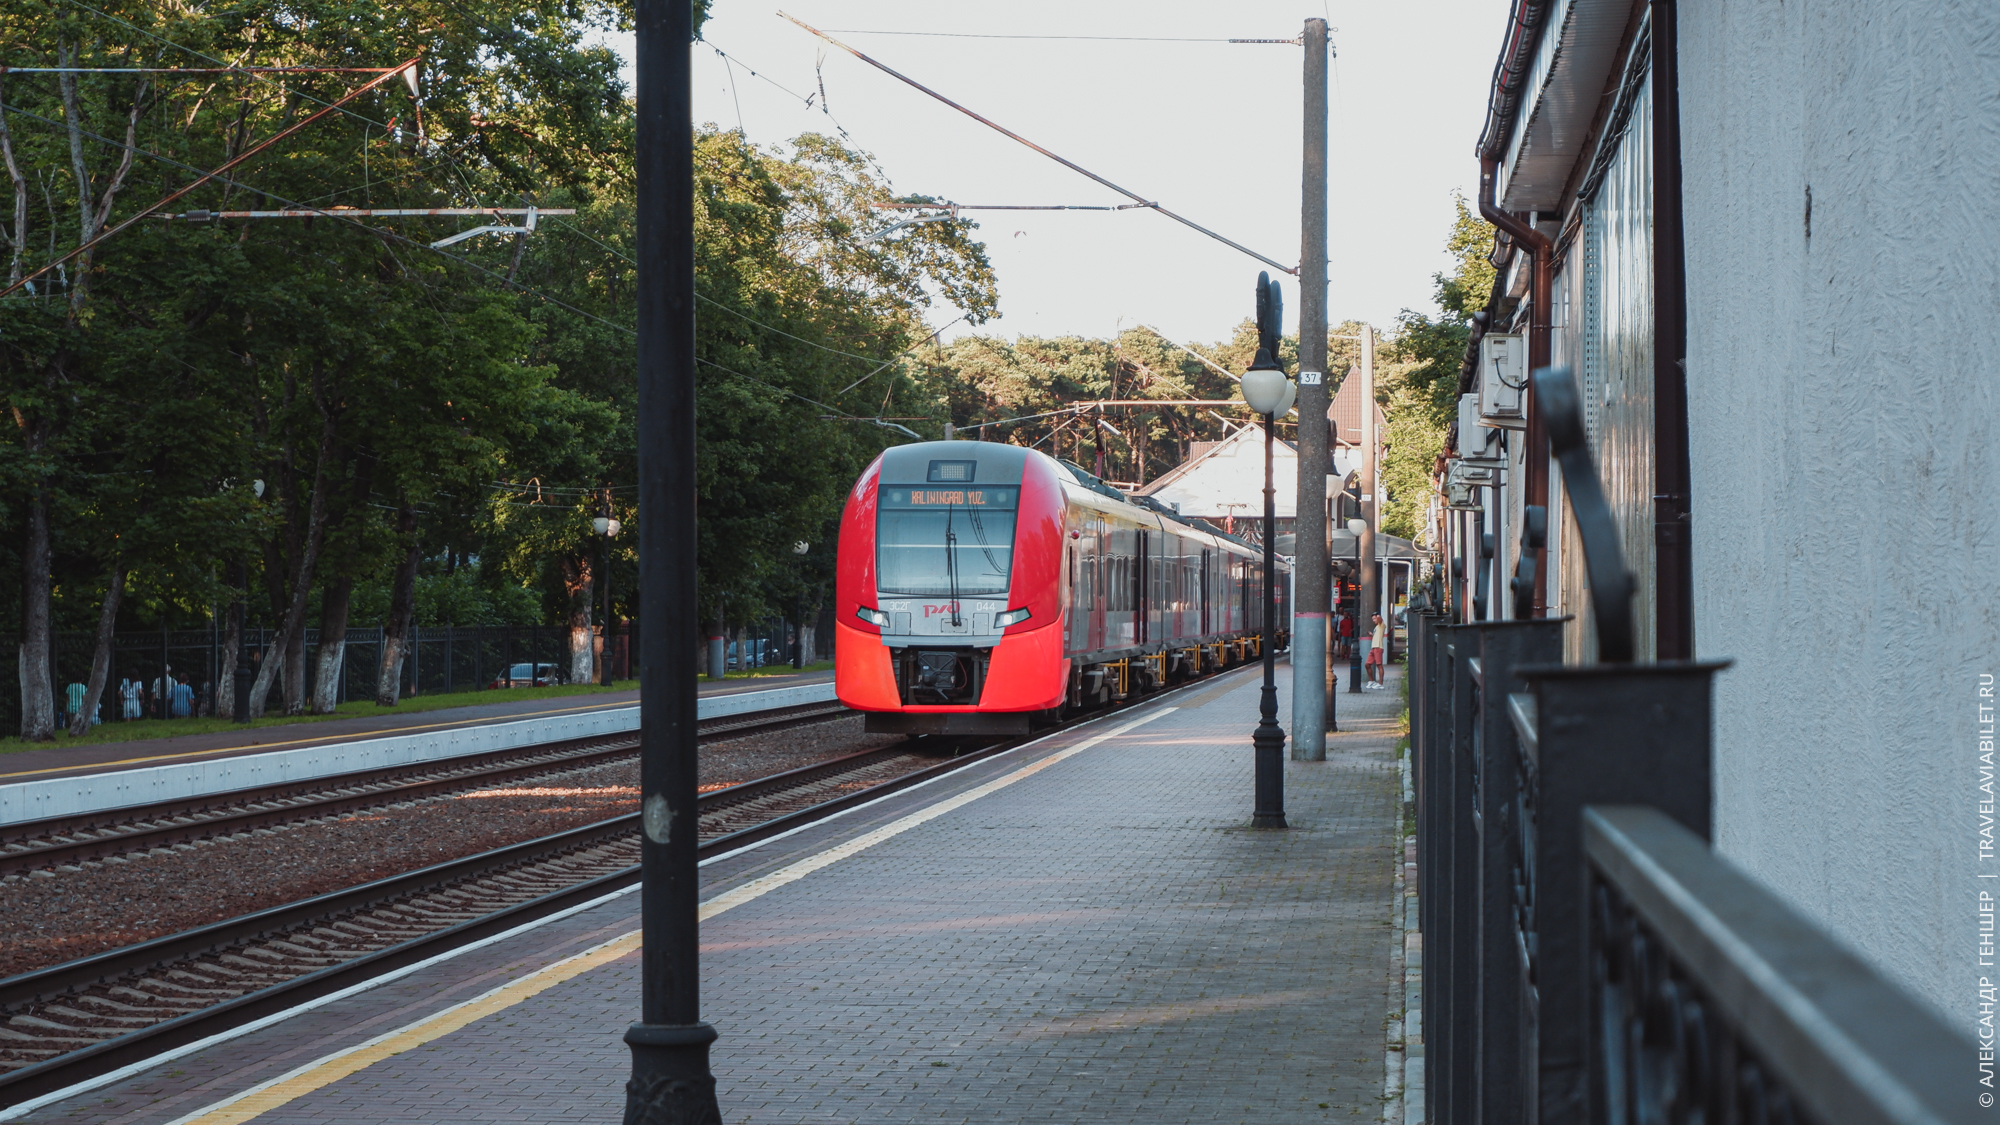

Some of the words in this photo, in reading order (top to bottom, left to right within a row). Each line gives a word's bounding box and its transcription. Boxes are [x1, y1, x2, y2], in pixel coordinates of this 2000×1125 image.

[1305, 373, 1316, 382] 37
[911, 490, 964, 504] KALININGRAD
[976, 601, 996, 611] 044
